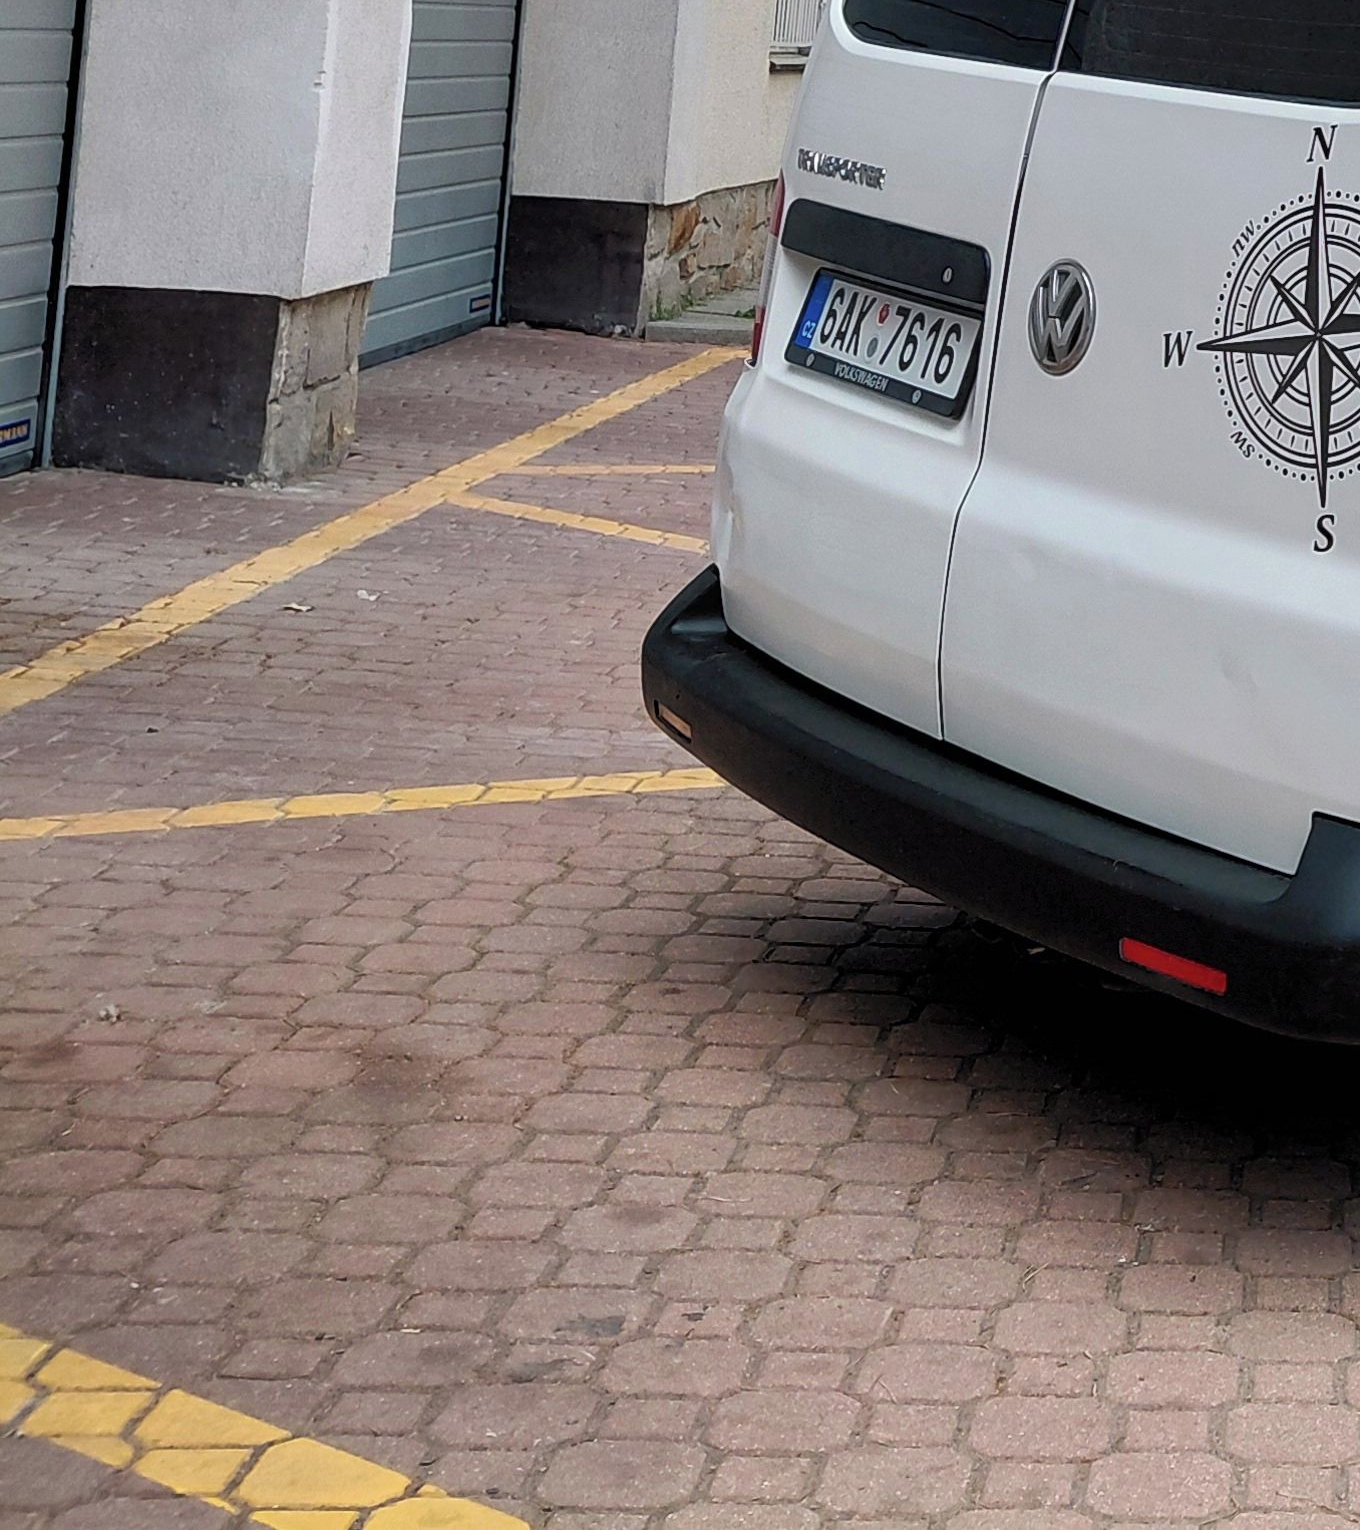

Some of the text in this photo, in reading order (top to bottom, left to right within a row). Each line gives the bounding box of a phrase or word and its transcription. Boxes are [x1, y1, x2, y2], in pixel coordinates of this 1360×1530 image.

[1306, 124, 1338, 163] N
[802, 321, 817, 339] CZ
[819, 287, 963, 385] 6AK 7616
[1162, 330, 1193, 368] W
[833, 362, 890, 393] VOLKSWAGEN
[1313, 514, 1336, 553] S
